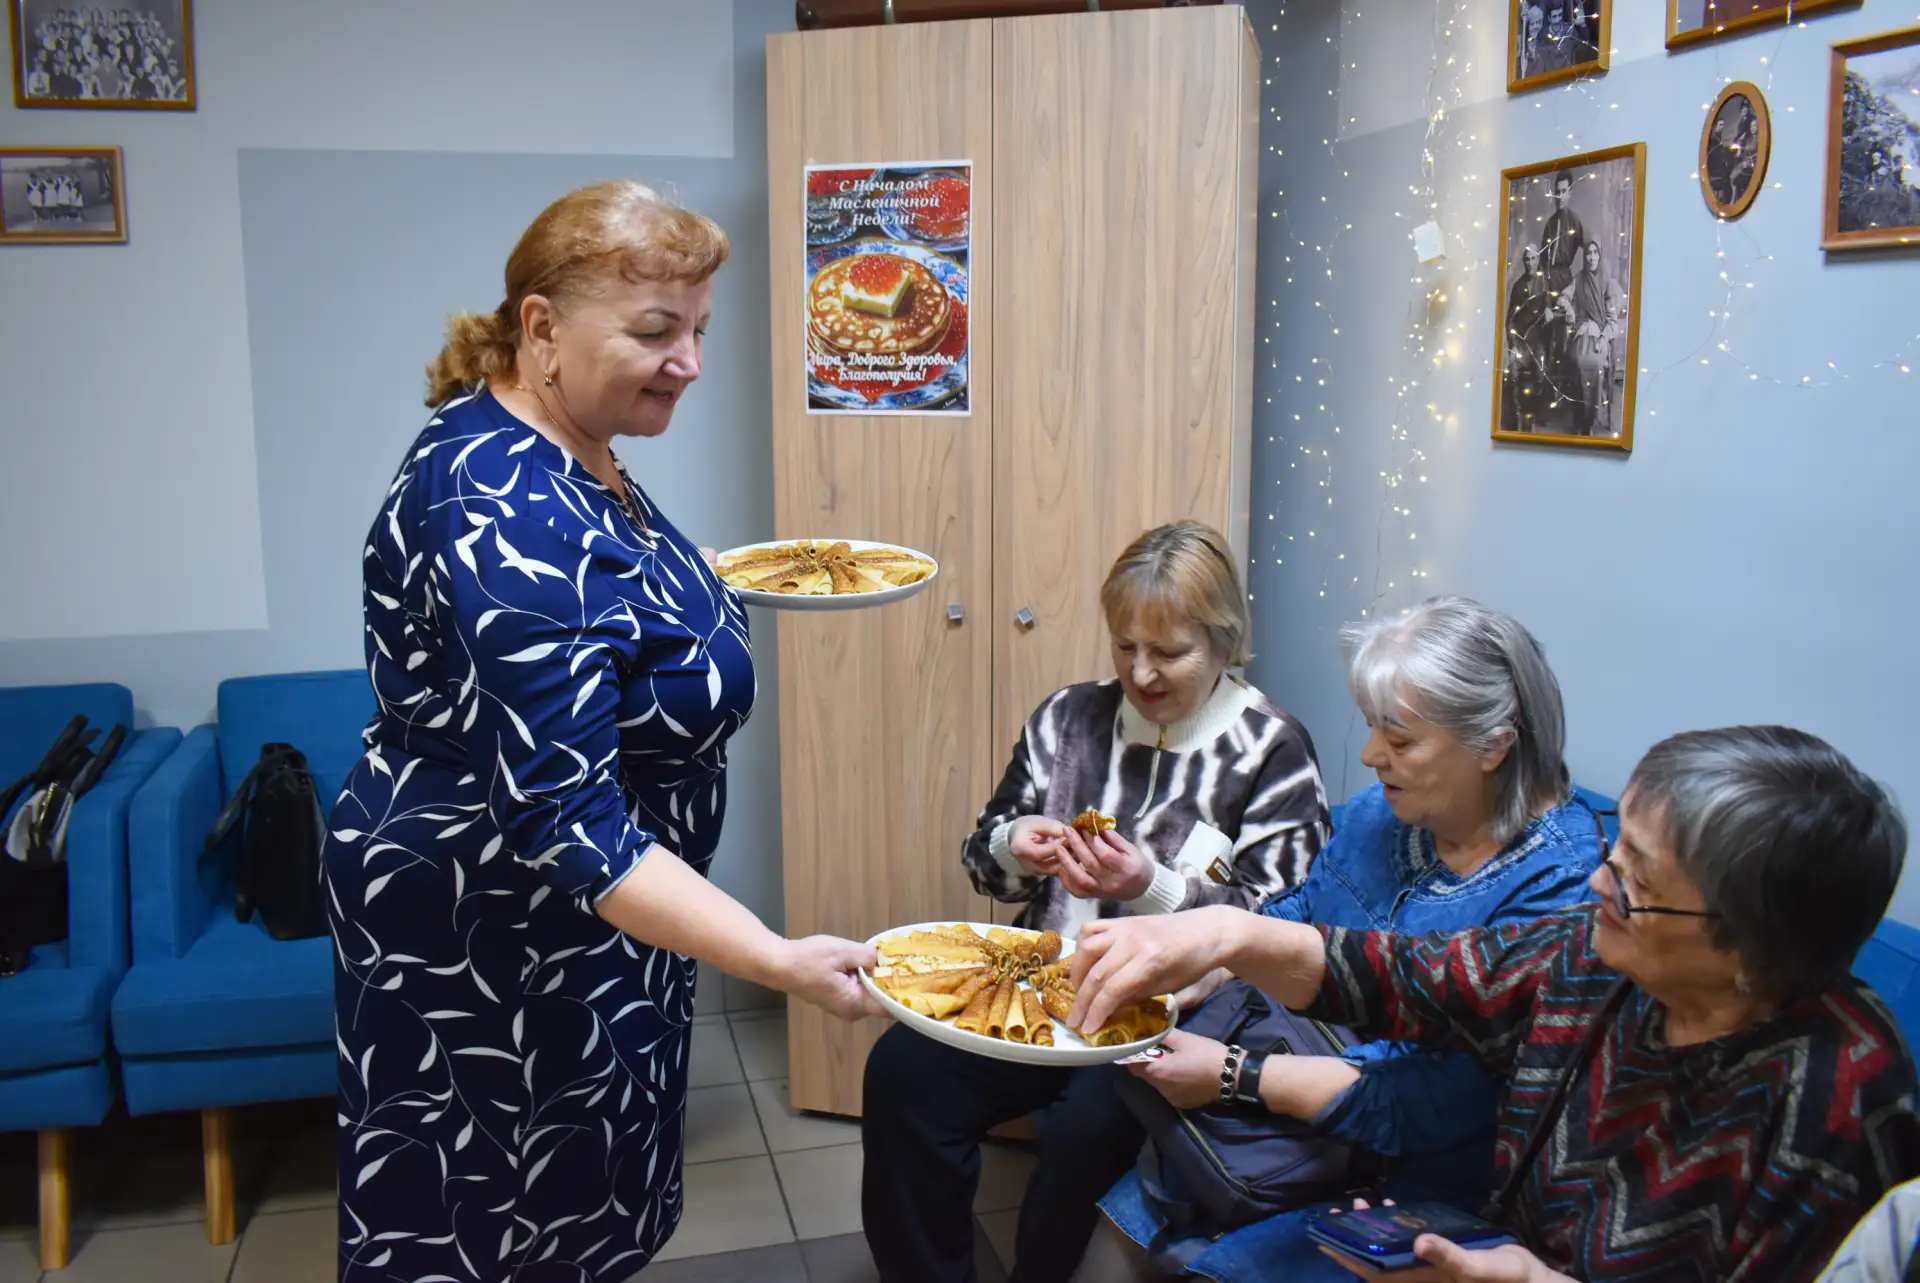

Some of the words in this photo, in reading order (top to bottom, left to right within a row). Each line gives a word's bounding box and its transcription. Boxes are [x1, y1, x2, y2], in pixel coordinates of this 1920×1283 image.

[853, 179, 929, 192] Началом
[829, 194, 941, 210] Масленичной
[852, 212, 915, 225] Недели!
[848, 352, 895, 370] Доброго
[899, 351, 957, 371] Здоровья,
[838, 366, 927, 386] Благополучия!
